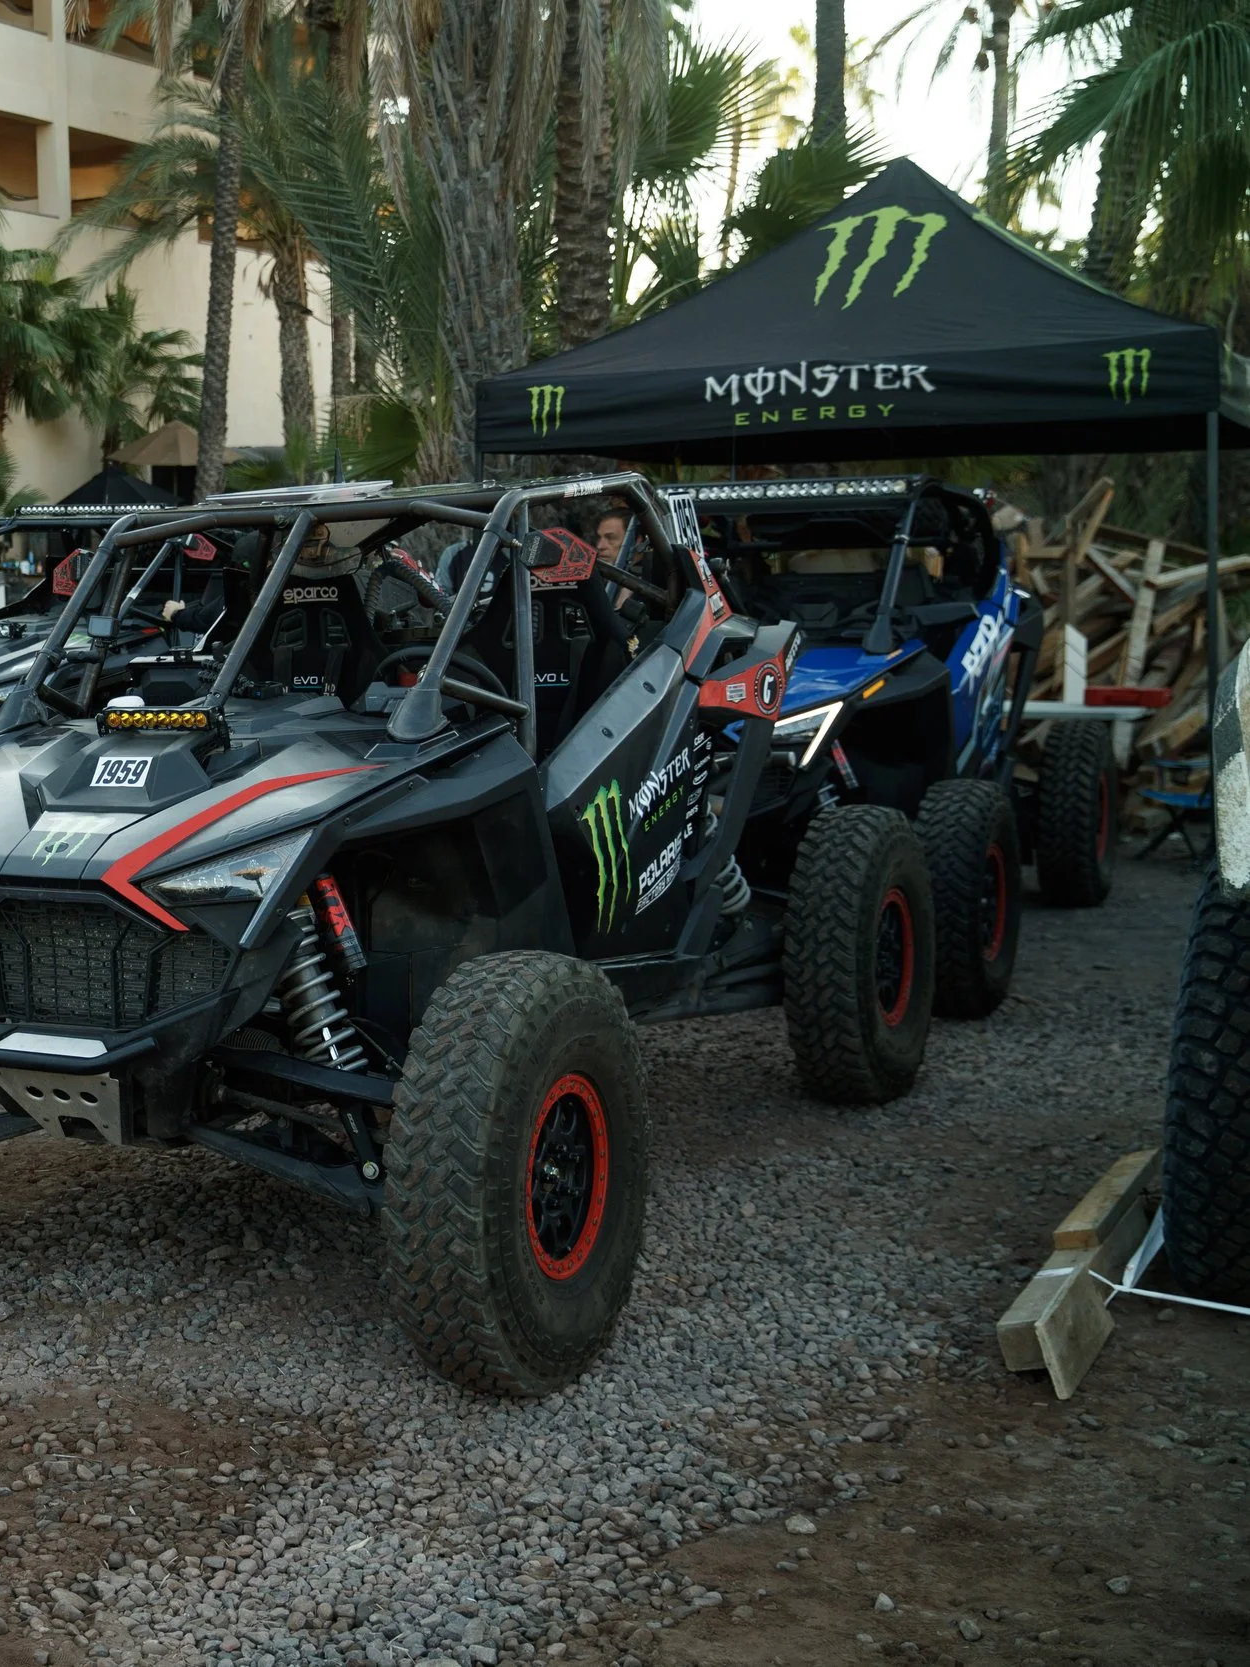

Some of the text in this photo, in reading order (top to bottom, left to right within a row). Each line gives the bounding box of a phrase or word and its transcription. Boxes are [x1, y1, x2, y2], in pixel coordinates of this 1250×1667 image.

[705, 361, 935, 405] MONSTER
[735, 403, 896, 426] ENERGY
[283, 586, 339, 603] sparco
[293, 675, 319, 685] EVO
[95, 759, 149, 785] 1959
[628, 747, 692, 821] MONSTER
[644, 785, 685, 832] ENERGY
[638, 831, 683, 896] POLARIS
